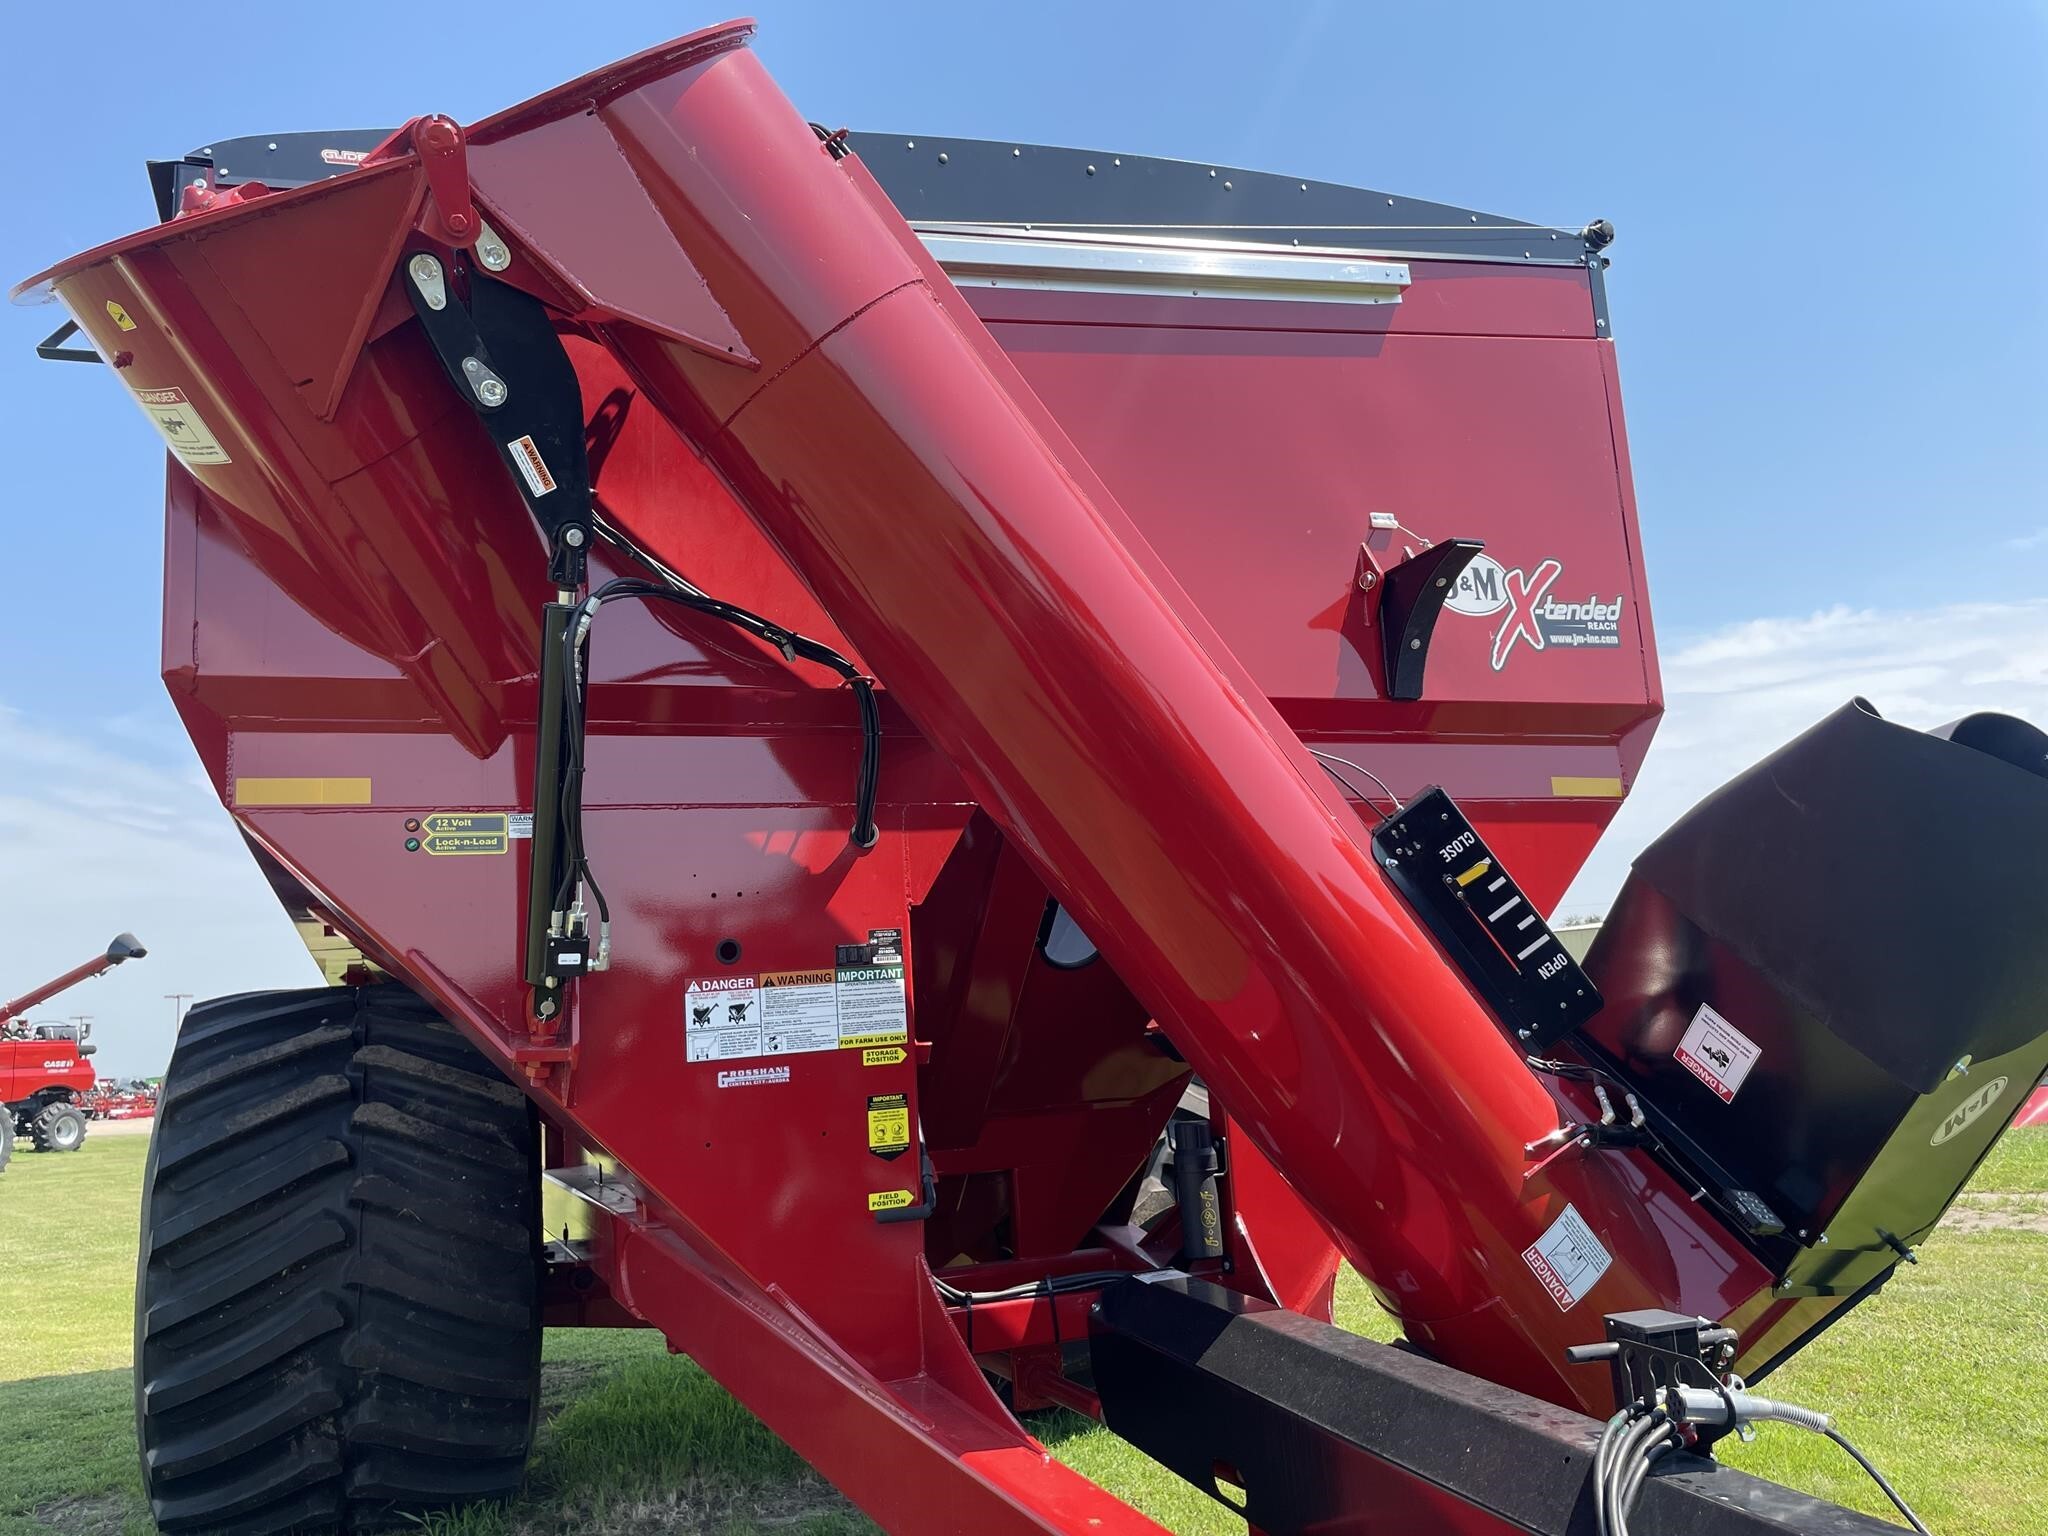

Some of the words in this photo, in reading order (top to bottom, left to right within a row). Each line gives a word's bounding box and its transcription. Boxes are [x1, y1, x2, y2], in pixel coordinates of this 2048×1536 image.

[528, 448, 551, 486] WARNING
[1587, 621, 1617, 630] REACH
[1550, 633, 1618, 646] www.jm-inc.com
[436, 819, 449, 827] 12
[451, 819, 472, 827] Volt
[436, 838, 498, 846] Lock-n-Load
[1439, 831, 1475, 863] CLOSE
[1537, 952, 1568, 980] OPEN
[777, 973, 832, 985] WARNING
[838, 968, 903, 981] IMPORTANT
[702, 978, 754, 991] DANGER
[841, 1038, 854, 1046] FOR
[890, 1034, 907, 1042] ONLY
[866, 1049, 899, 1057] STORAGE
[866, 1055, 900, 1063] POSITION
[43, 1060, 66, 1068] CASE
[1681, 1053, 1717, 1088] DANGER
[718, 1066, 790, 1088] GROSSHANS
[873, 1094, 903, 1102] IMPORTANT
[1945, 1083, 1999, 1136] J&M
[872, 1198, 906, 1207] POSITION
[878, 1193, 899, 1201] FIELD
[1526, 1248, 1565, 1298] DANGER
